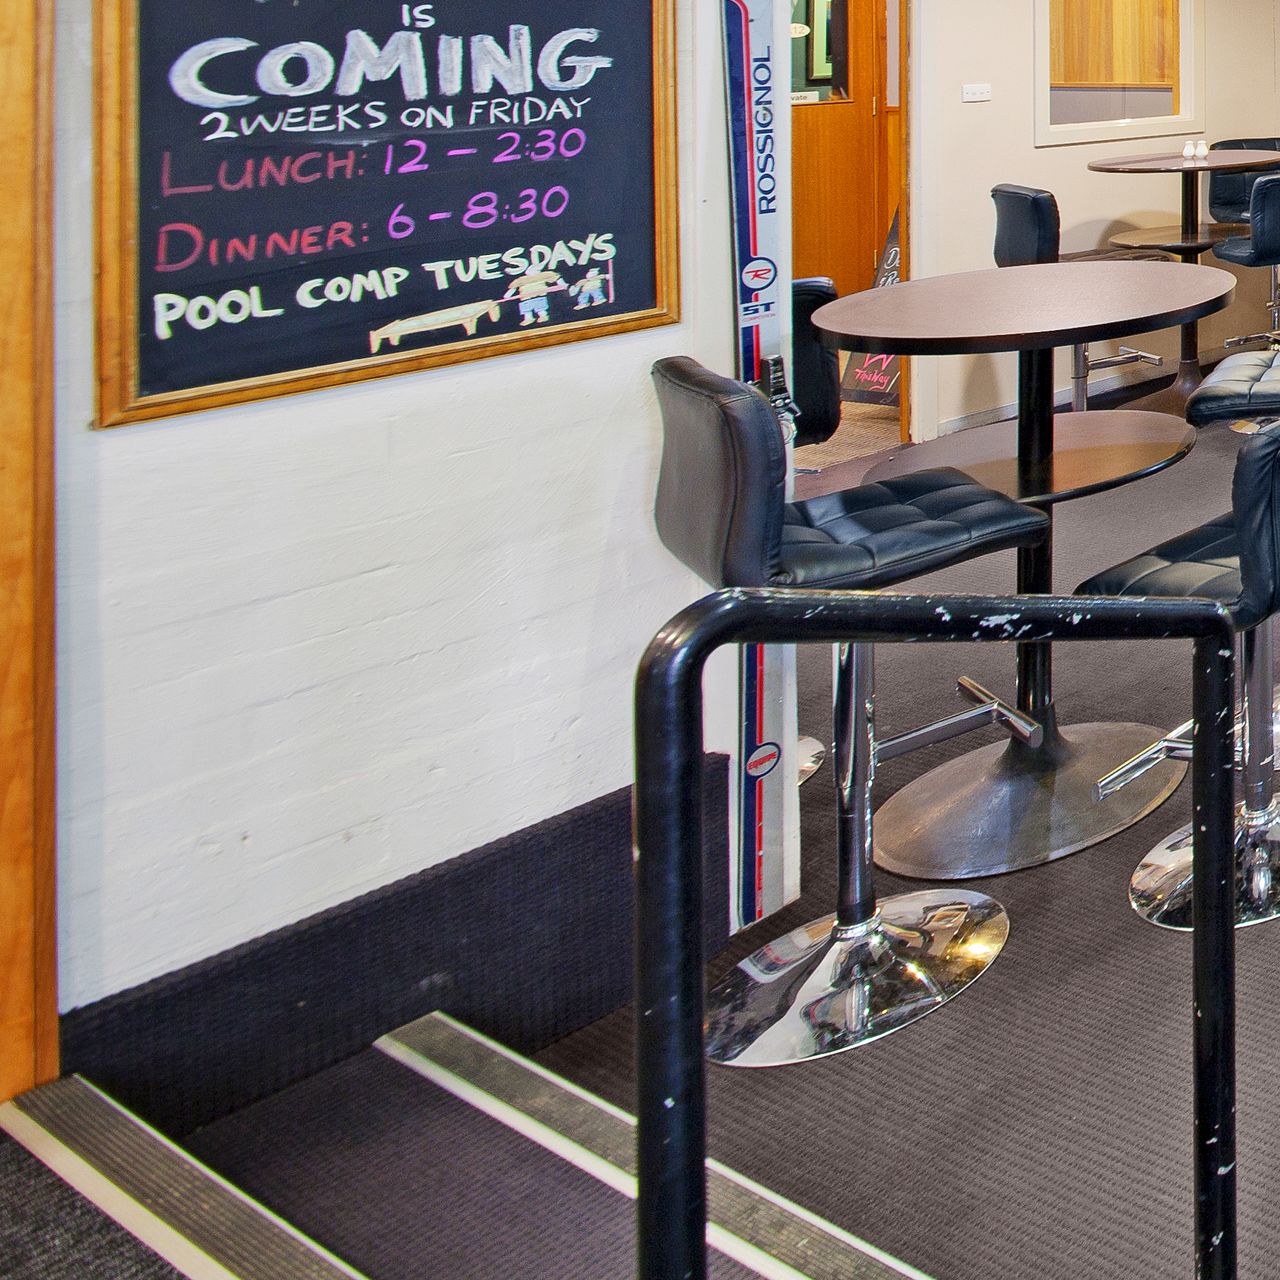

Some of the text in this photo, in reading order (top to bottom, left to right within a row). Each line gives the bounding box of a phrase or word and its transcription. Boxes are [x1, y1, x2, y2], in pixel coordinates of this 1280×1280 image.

[402, 3, 436, 28] IS
[170, 25, 612, 108] COMING
[402, 103, 454, 129] ON
[468, 94, 593, 125] FRIDAY
[752, 45, 777, 216] ROSSIGNOL
[160, 150, 367, 198] LUNCH:
[383, 138, 430, 174] 12
[491, 127, 587, 164] 2:30
[154, 218, 370, 272] DINNER:
[386, 202, 415, 240] 6
[462, 184, 570, 228] 8:30
[153, 232, 617, 340] POOL COMP TUESDAYS
[743, 301, 775, 316] ST
